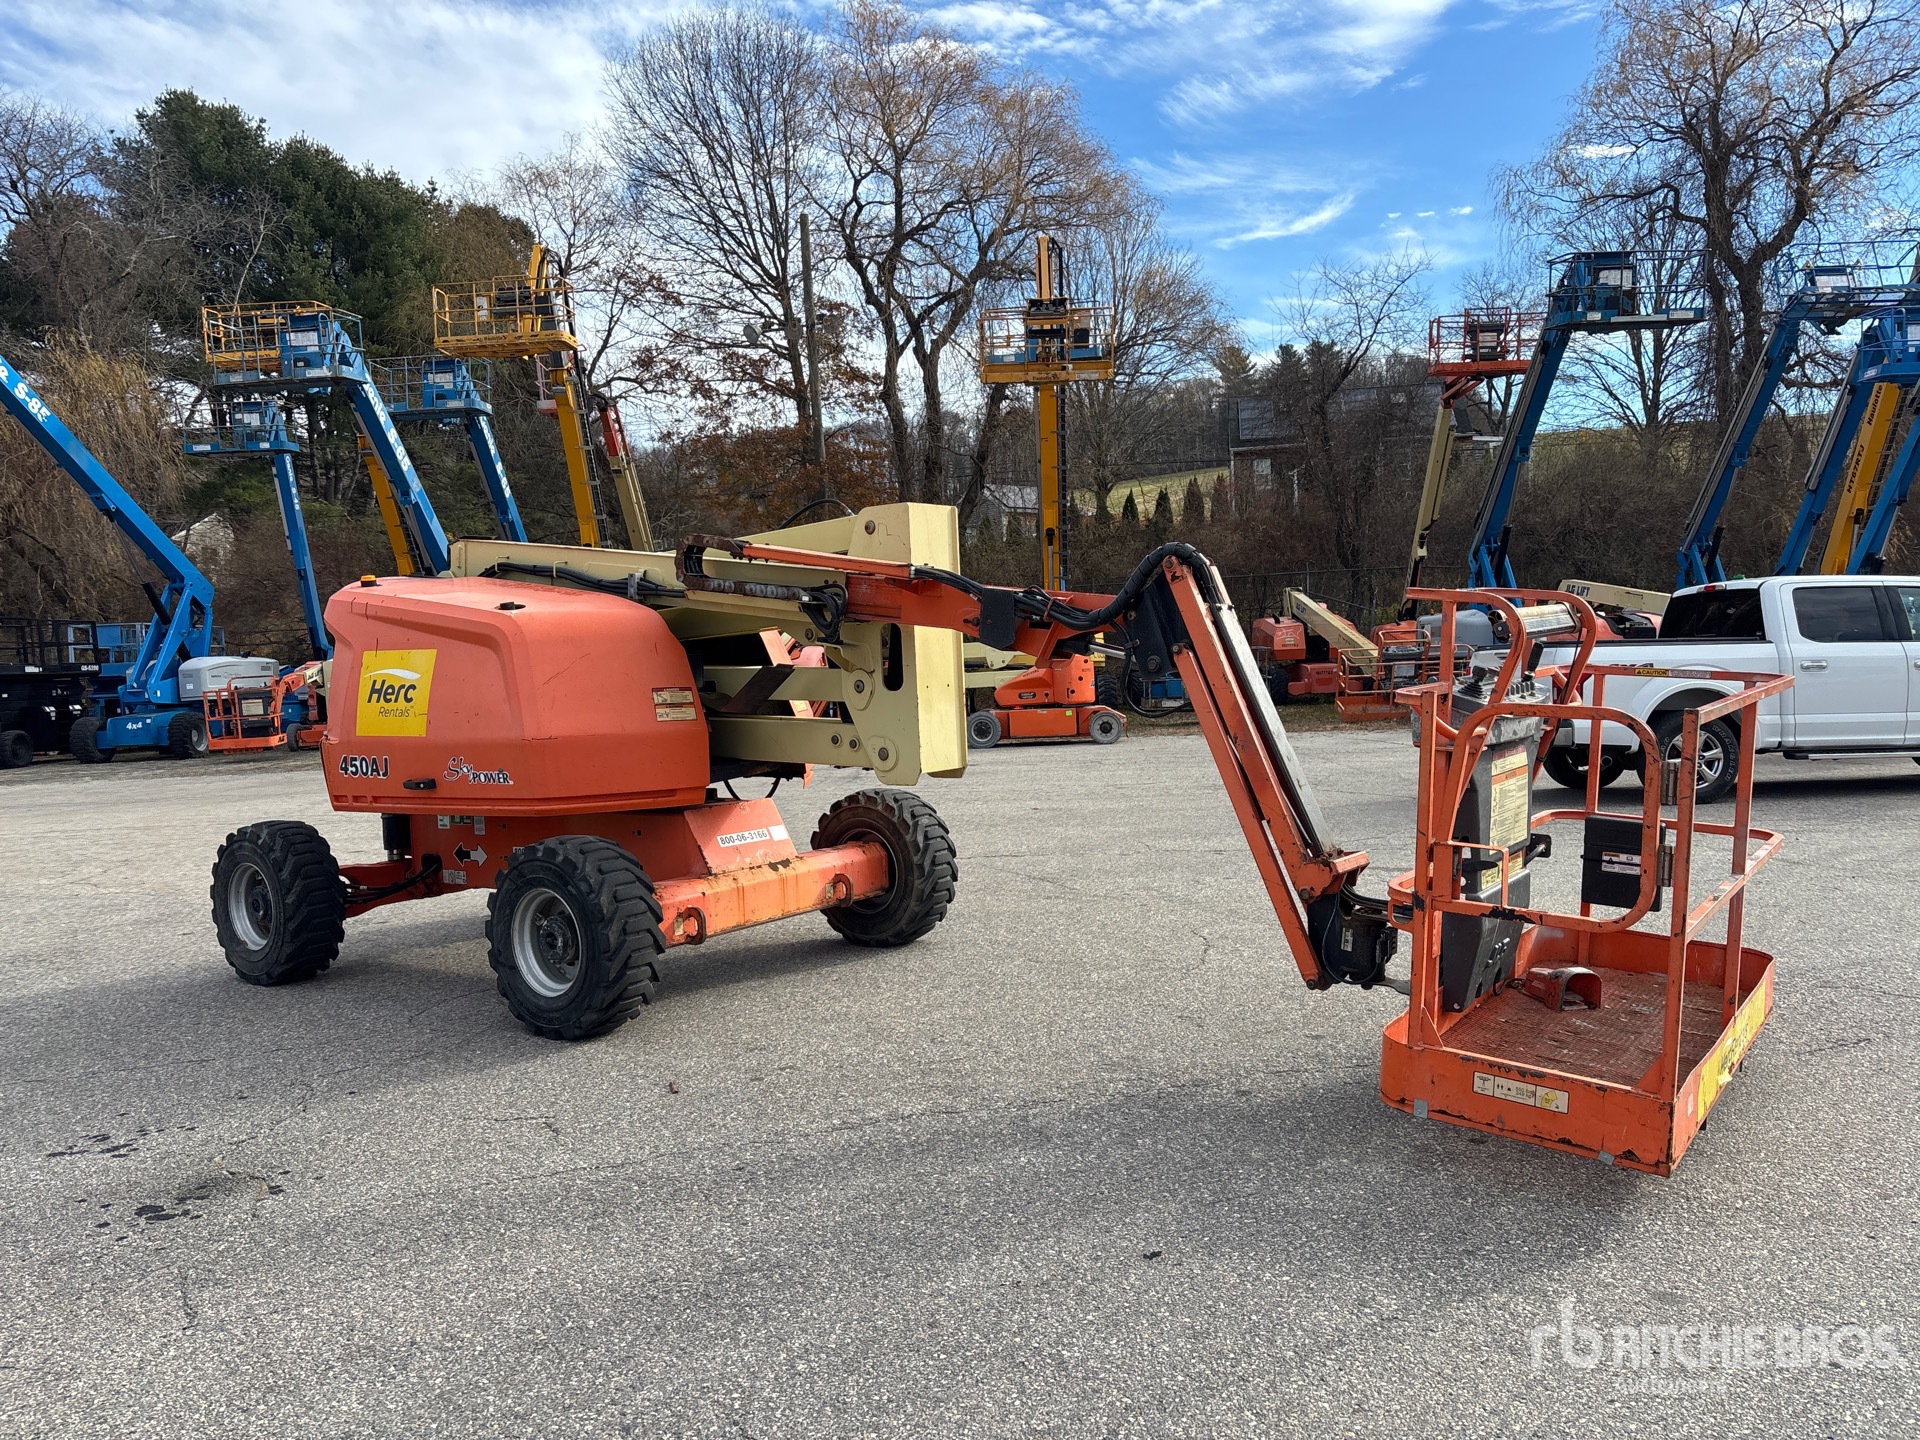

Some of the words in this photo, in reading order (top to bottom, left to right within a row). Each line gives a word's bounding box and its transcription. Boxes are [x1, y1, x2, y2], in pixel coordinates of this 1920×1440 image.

[14, 382, 52, 422] S-85
[1866, 384, 1883, 426] Haulotte
[387, 427, 411, 472] S-65
[1576, 586, 1591, 598] LIFT
[367, 679, 417, 704] Herc
[378, 706, 411, 718] Rentals
[126, 721, 143, 731] 4x4
[339, 755, 390, 779] 450AJ
[443, 756, 473, 784] Sky
[470, 770, 511, 785] POWER
[719, 829, 768, 846] 800-06-3166
